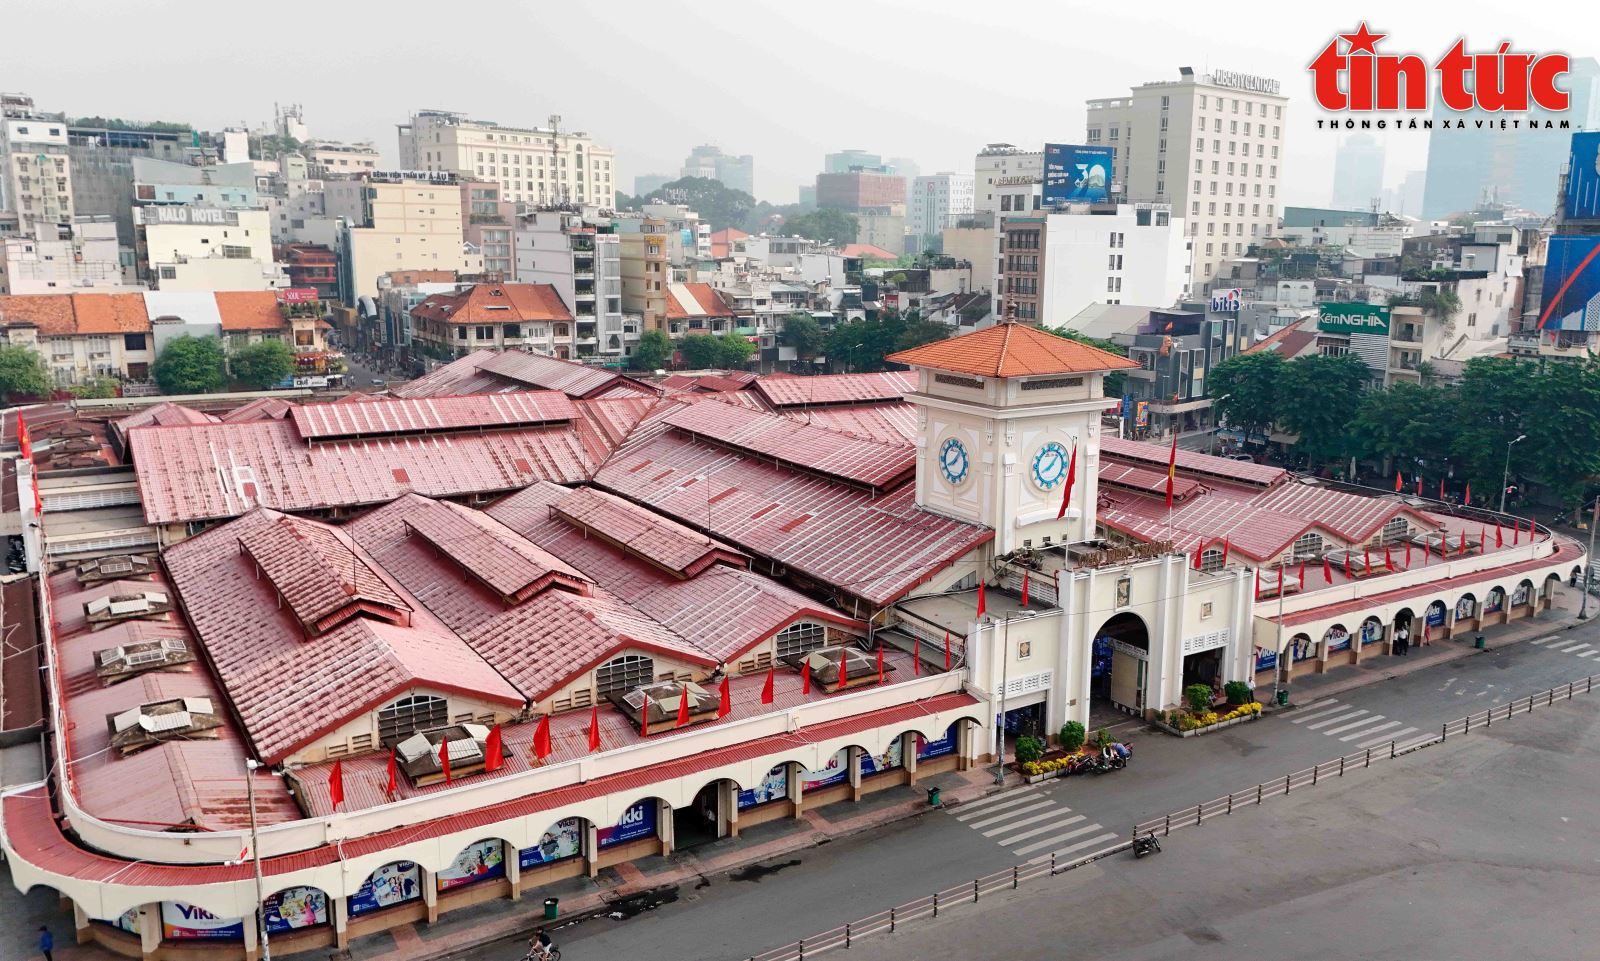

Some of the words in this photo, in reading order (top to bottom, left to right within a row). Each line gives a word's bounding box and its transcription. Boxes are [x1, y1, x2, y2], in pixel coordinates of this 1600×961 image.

[1216, 69, 1246, 89] LIBERTY
[159, 207, 187, 221] HALO
[192, 208, 225, 222] HOTEL
[618, 805, 643, 826] ikki
